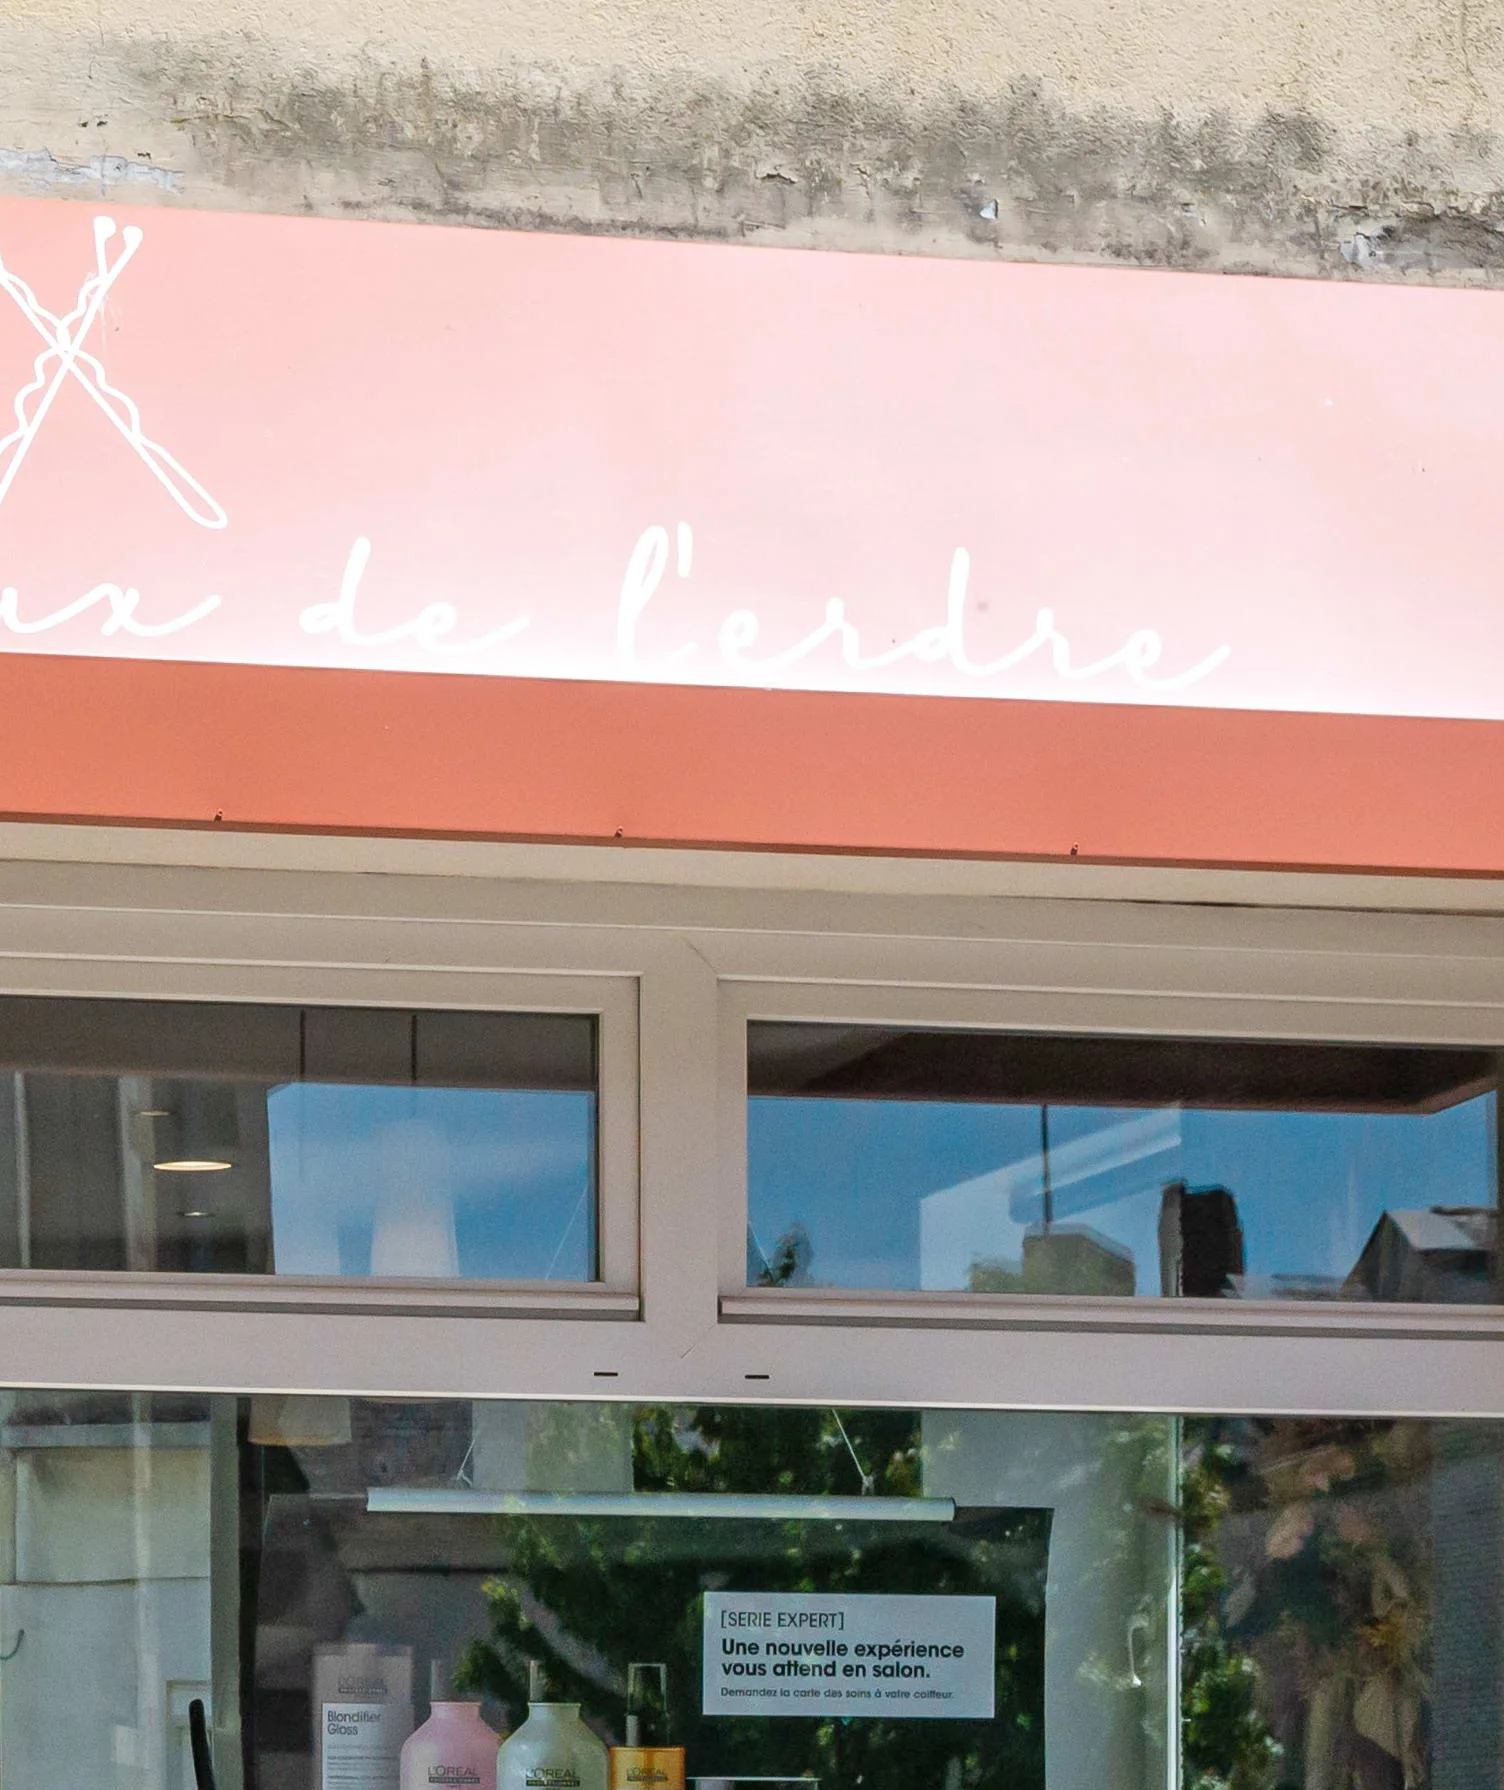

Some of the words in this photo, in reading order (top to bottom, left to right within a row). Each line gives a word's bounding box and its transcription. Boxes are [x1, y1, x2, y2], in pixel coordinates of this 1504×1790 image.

[298, 536, 530, 653] de
[722, 1638, 759, 1656] Une
[766, 1639, 848, 1657] nouvelle
[854, 1639, 965, 1661] expérience
[722, 1661, 767, 1676] vous
[773, 1660, 837, 1678] attend
[842, 1663, 867, 1678] en
[872, 1661, 931, 1679] salon.
[720, 1687, 777, 1698] Demandez
[779, 1687, 790, 1698] la
[793, 1688, 821, 1699] carte
[824, 1688, 843, 1699] des
[845, 1688, 872, 1699] soins
[874, 1687, 883, 1699] à
[327, 1710, 381, 1723] Blondifier
[327, 1723, 359, 1735] Gloss
